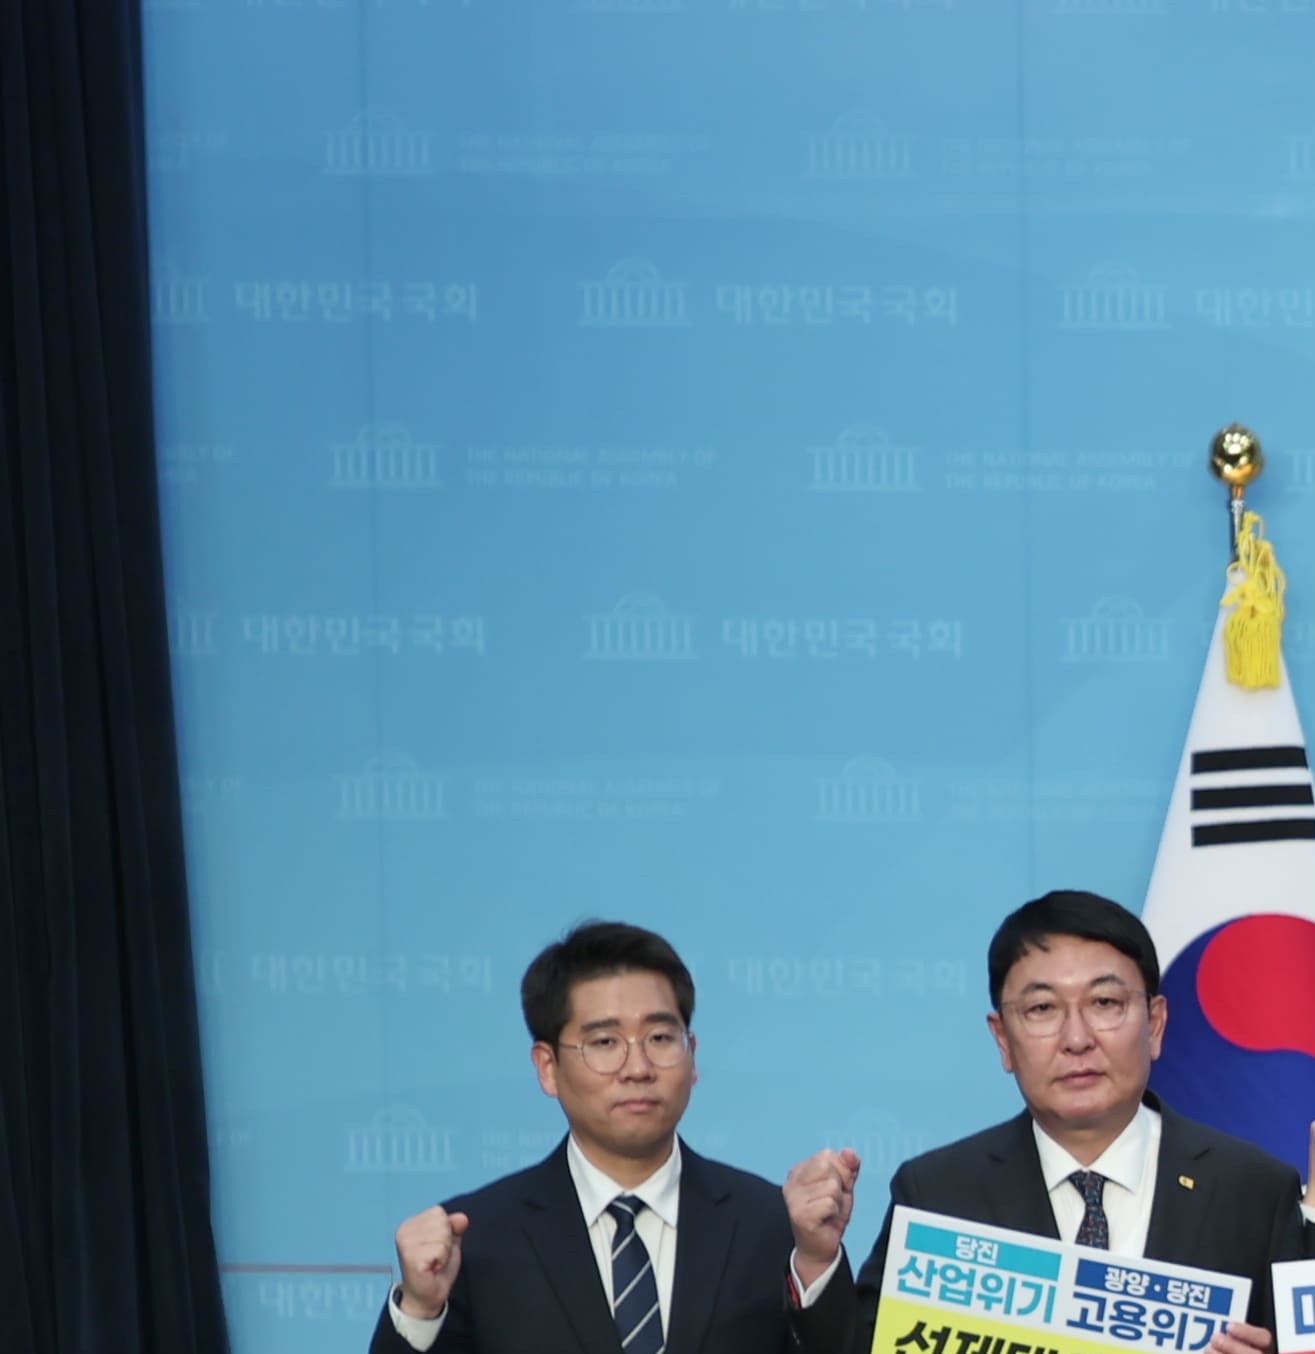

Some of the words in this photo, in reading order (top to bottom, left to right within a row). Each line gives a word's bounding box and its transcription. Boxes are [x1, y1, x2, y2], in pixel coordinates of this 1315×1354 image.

[955, 1236, 998, 1266] 당진
[897, 1255, 1056, 1323] 산업위기
[1066, 1291, 1229, 1352] 고용위기
